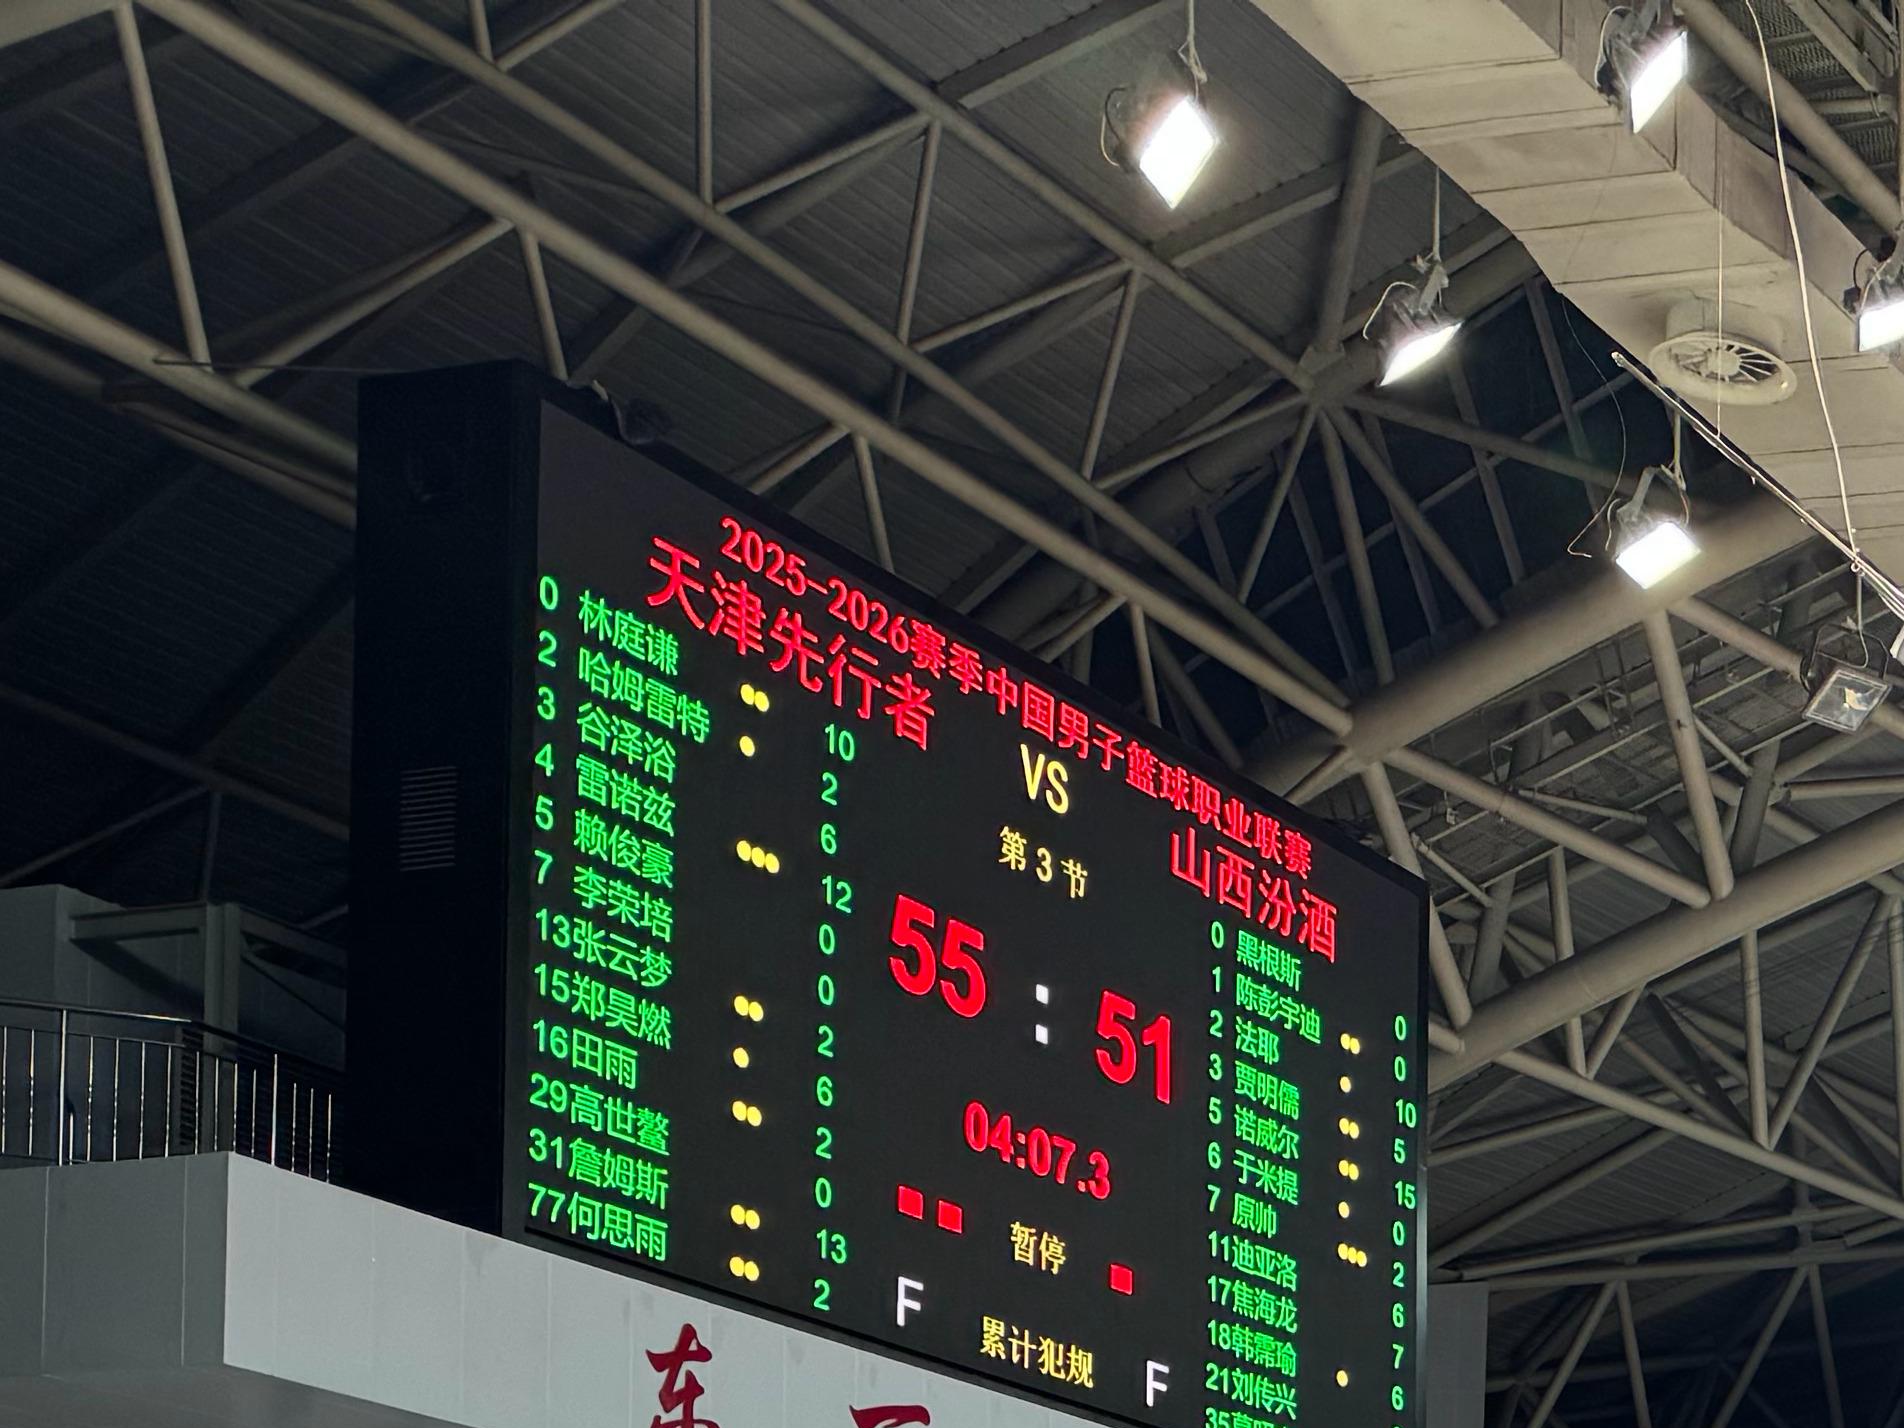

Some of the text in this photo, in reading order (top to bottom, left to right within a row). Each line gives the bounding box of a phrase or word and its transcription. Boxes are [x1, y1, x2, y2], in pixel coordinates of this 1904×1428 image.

[540, 576, 855, 761] 0 林庭谦 10
[647, 536, 935, 750] 天津先行者
[539, 631, 838, 805] 2 哈姆雷特 2
[721, 517, 1313, 879] 2025-2026赛季中国男子篮球职业联赛
[537, 687, 837, 854] 3 谷泽浴 6
[1019, 744, 1070, 814] VS
[535, 744, 853, 913] 4 雷诺兹 12
[535, 796, 835, 956] 5 赖俊豪 0
[535, 850, 835, 1006] 7 李荣培 0
[1169, 827, 1338, 964] 山西汾酒
[888, 893, 988, 1018] 55
[1096, 990, 1173, 1104] 51
[1211, 921, 1407, 1040] 0 黑根斯 0
[1212, 966, 1221, 992] 1
[1394, 1056, 1406, 1081] 0
[817, 1076, 833, 1107] 6
[818, 1025, 834, 1058] 2
[1209, 1010, 1416, 1128] 2 法耶 10
[816, 1128, 832, 1159] 2
[963, 1101, 1112, 1200] 04:07.3
[1209, 1053, 1222, 1081] 3
[1394, 1138, 1406, 1164] 5
[1209, 1097, 1416, 1210] 5 诺威尔 15
[815, 1177, 832, 1208] 0
[1207, 1184, 1405, 1288] 7 原帅 2
[1208, 1141, 1405, 1246] 6 于米提 0
[813, 1279, 830, 1311] 2
[816, 1229, 847, 1264] 13
[1010, 1221, 1067, 1275] 暂停
[896, 1276, 924, 1327] F
[979, 1315, 1095, 1389] 累计犯规
[1392, 1302, 1405, 1328] 6
[1146, 1360, 1170, 1407] F
[1391, 1385, 1404, 1411] 6
[1392, 1343, 1405, 1370] 7
